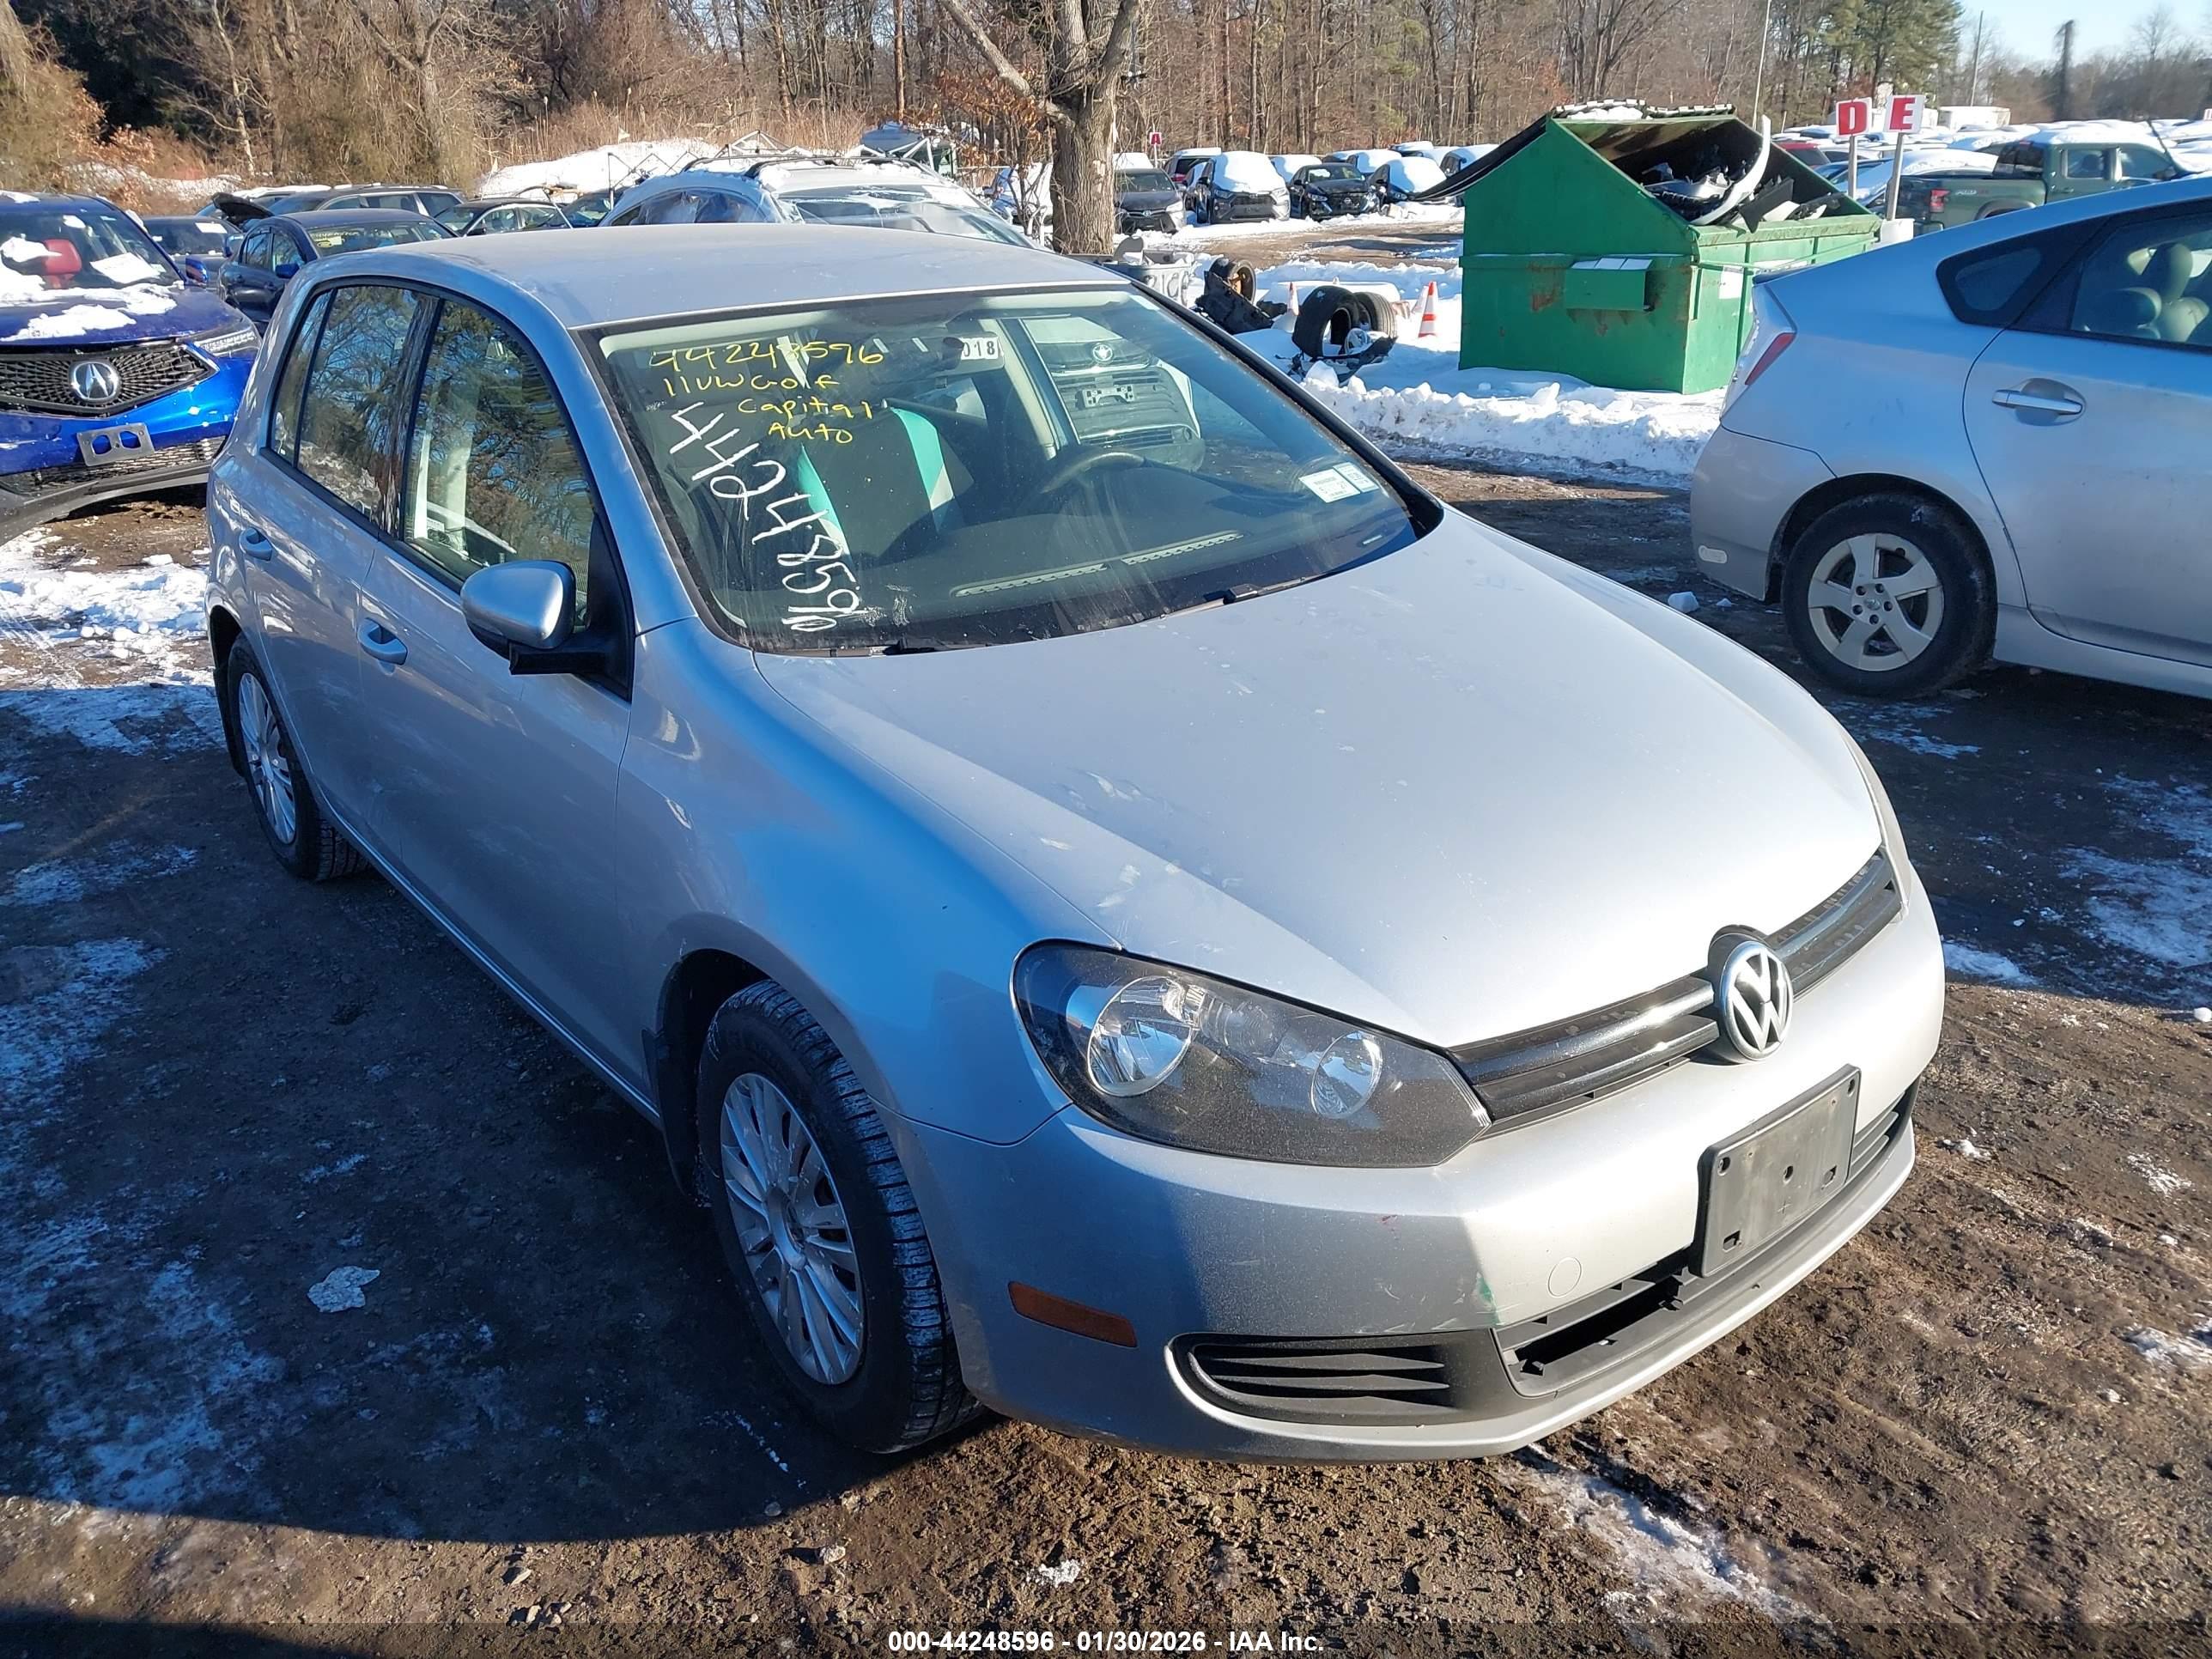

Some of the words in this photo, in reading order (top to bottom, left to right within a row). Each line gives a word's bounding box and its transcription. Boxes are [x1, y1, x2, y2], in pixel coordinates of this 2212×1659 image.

[1838, 100, 1868, 136] D
[1888, 97, 1916, 131] E
[1151, 133, 1161, 145] A
[768, 422, 853, 444] Auto
